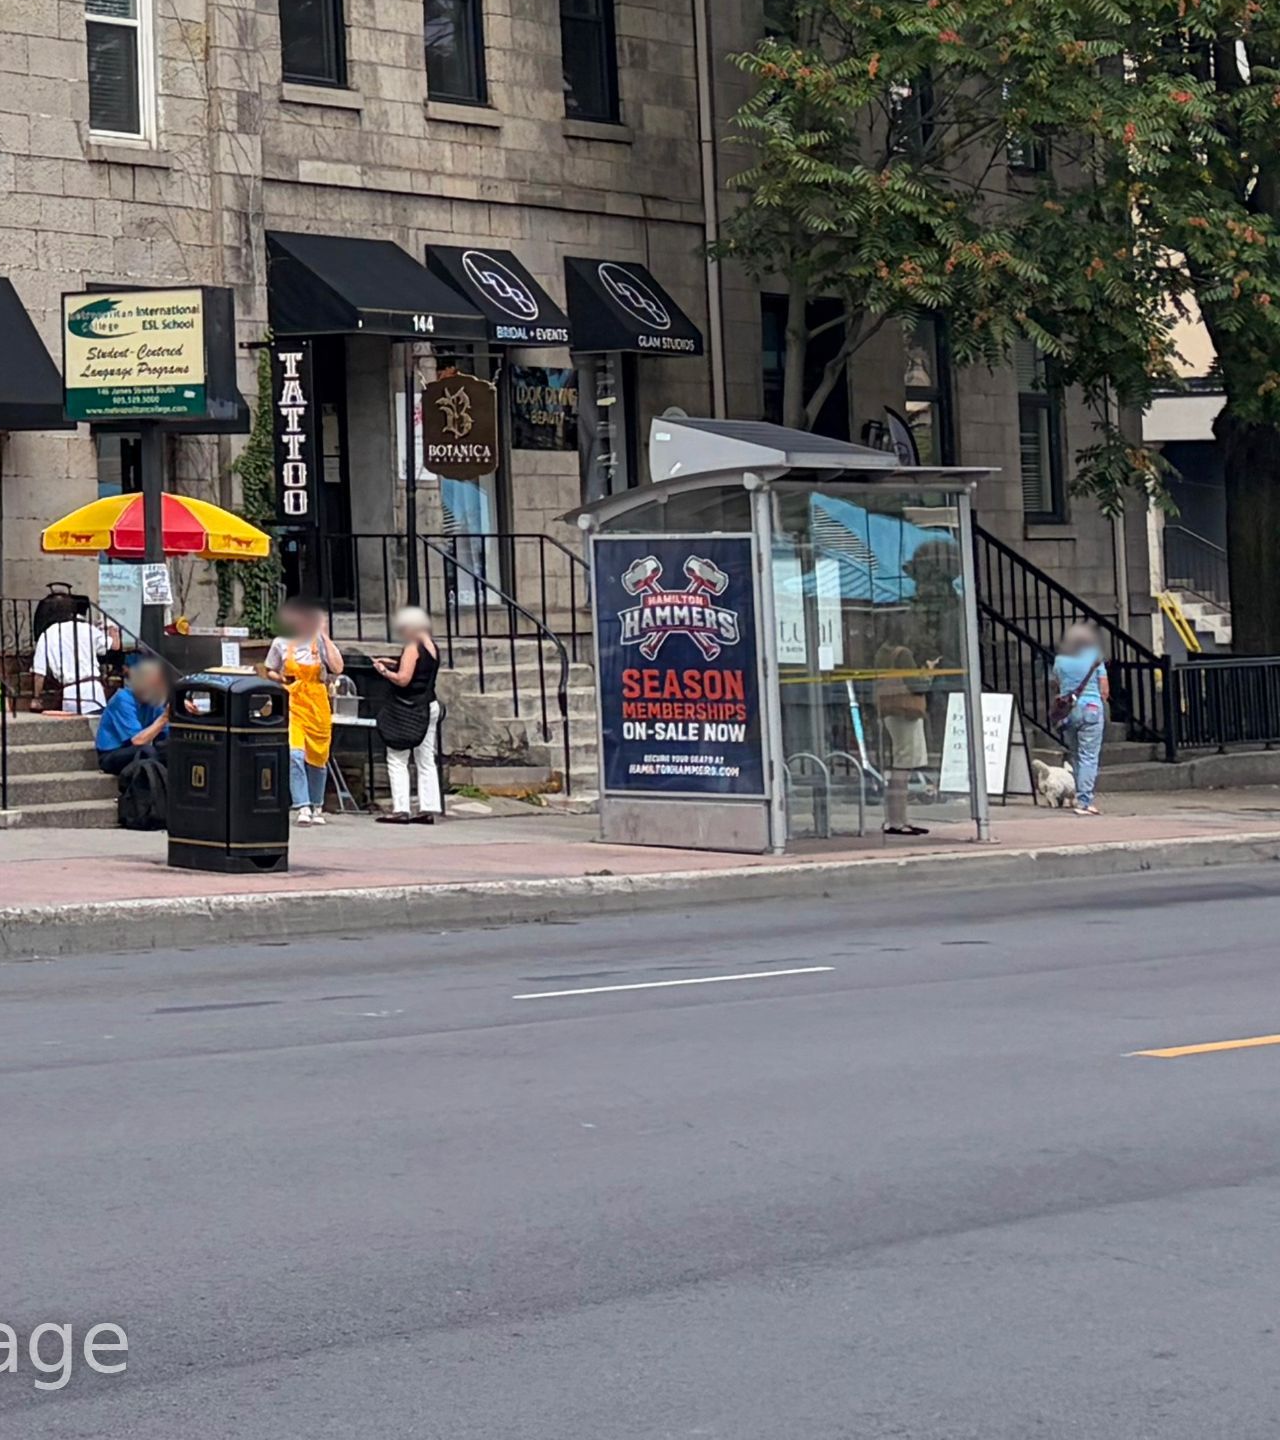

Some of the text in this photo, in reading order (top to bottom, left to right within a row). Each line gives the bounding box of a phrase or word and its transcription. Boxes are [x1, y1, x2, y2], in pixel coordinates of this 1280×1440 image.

[136, 304, 200, 317] International
[141, 320, 159, 331] ESL
[161, 318, 195, 330] School
[413, 314, 435, 333] 144
[496, 326, 528, 340] BRIDAL
[536, 327, 569, 342] EVENTS
[637, 335, 695, 352] GLAM STUDIOS
[80, 361, 190, 381] Language Programs
[111, 388, 132, 396] James
[133, 386, 154, 395] Street
[155, 385, 176, 394] South
[277, 352, 309, 516] TATTOO
[428, 444, 491, 457] BOTANICA
[647, 593, 704, 607] HAMILTON
[624, 605, 735, 640] HAMMERS
[621, 668, 746, 700] SEASON
[622, 701, 748, 721] MEMBERSHIPS
[622, 721, 747, 743] ON-SALE NOW
[643, 753, 724, 765] SECURE YOUR SEATS AT
[628, 764, 740, 778] HAMILTONHAMMERS.COM
